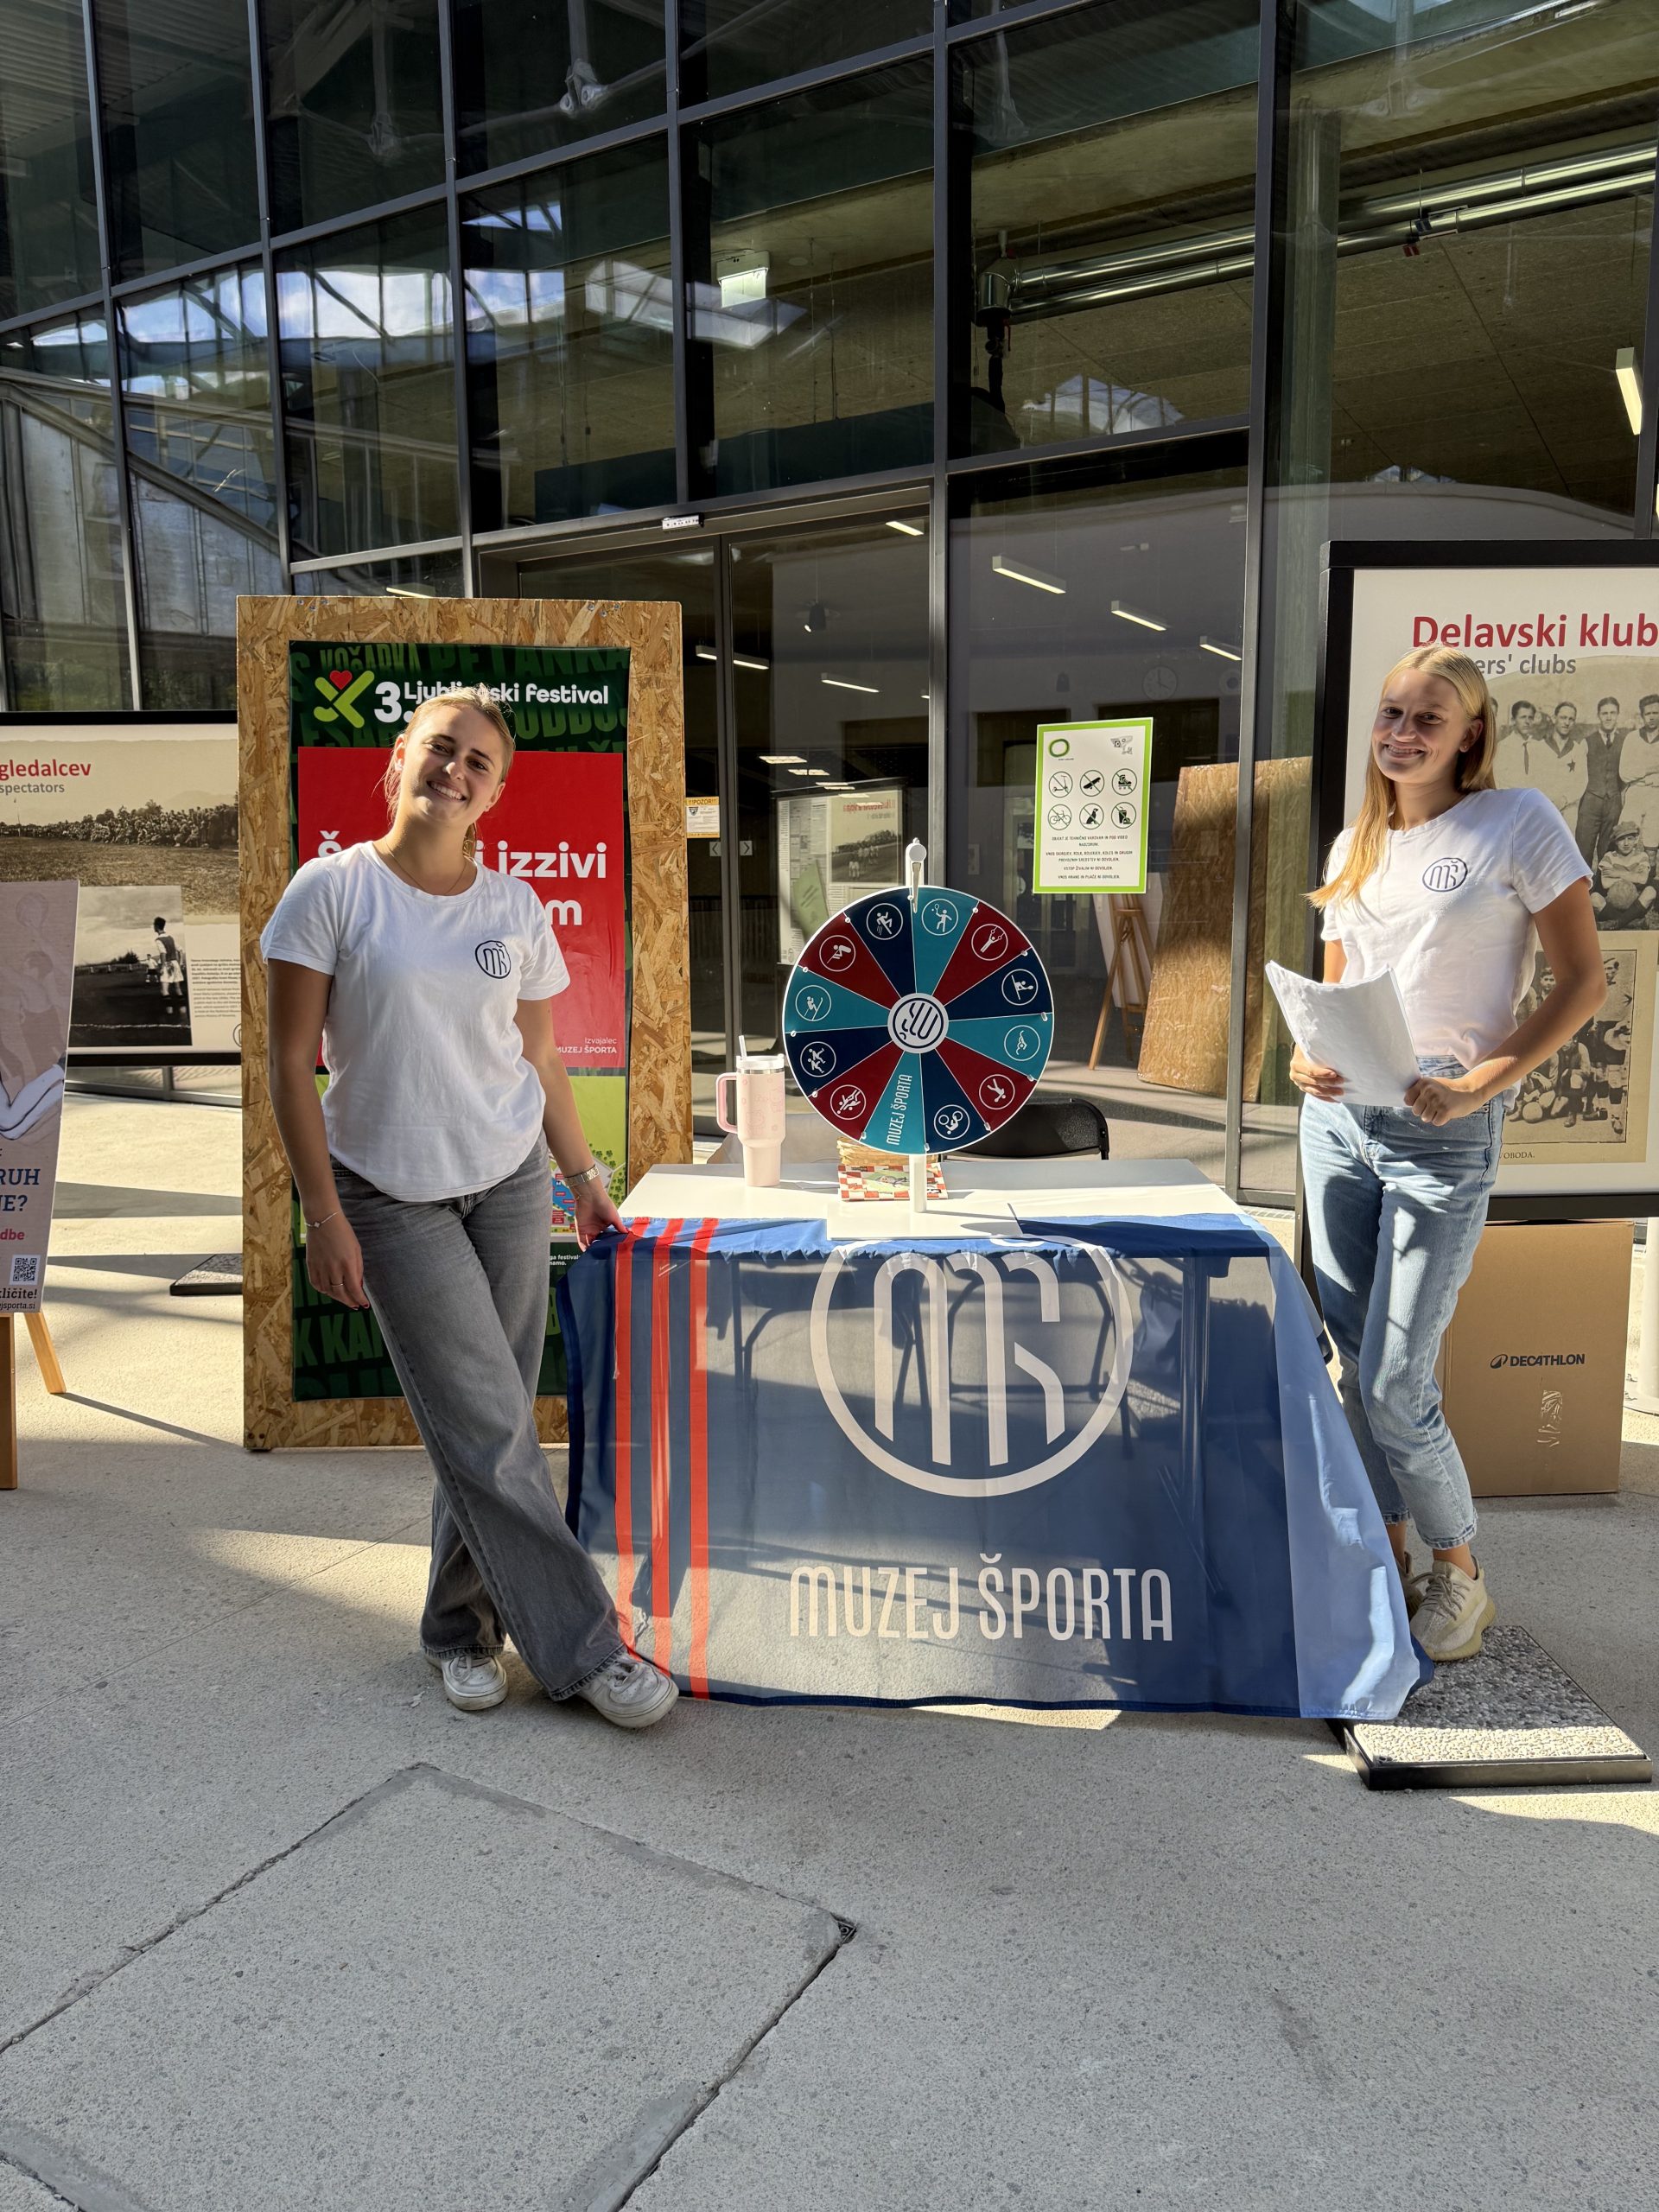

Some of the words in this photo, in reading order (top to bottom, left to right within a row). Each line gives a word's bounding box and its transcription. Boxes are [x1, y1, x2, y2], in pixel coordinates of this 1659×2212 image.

[1413, 613, 1567, 648] Delavski
[1580, 613, 1658, 647] klub
[1474, 653, 1512, 675] ers'
[1519, 653, 1577, 675] clubs
[374, 681, 414, 723] 3.
[404, 680, 520, 704] Ljubski
[525, 684, 609, 705] festival
[0, 783, 65, 796] spectators
[498, 840, 607, 879] izzivi
[584, 1045, 617, 1053] ŠPORTA
[890, 1074, 912, 1111] ŠPORTA
[887, 1111, 906, 1146] MUZEJ
[0, 1194, 28, 1211] E?
[0, 1301, 35, 1311] jsporta.si
[1510, 1353, 1586, 1367] DECATHLON
[789, 1566, 961, 1641] MUZEJ
[979, 1553, 1174, 1642] ŠPORTA
